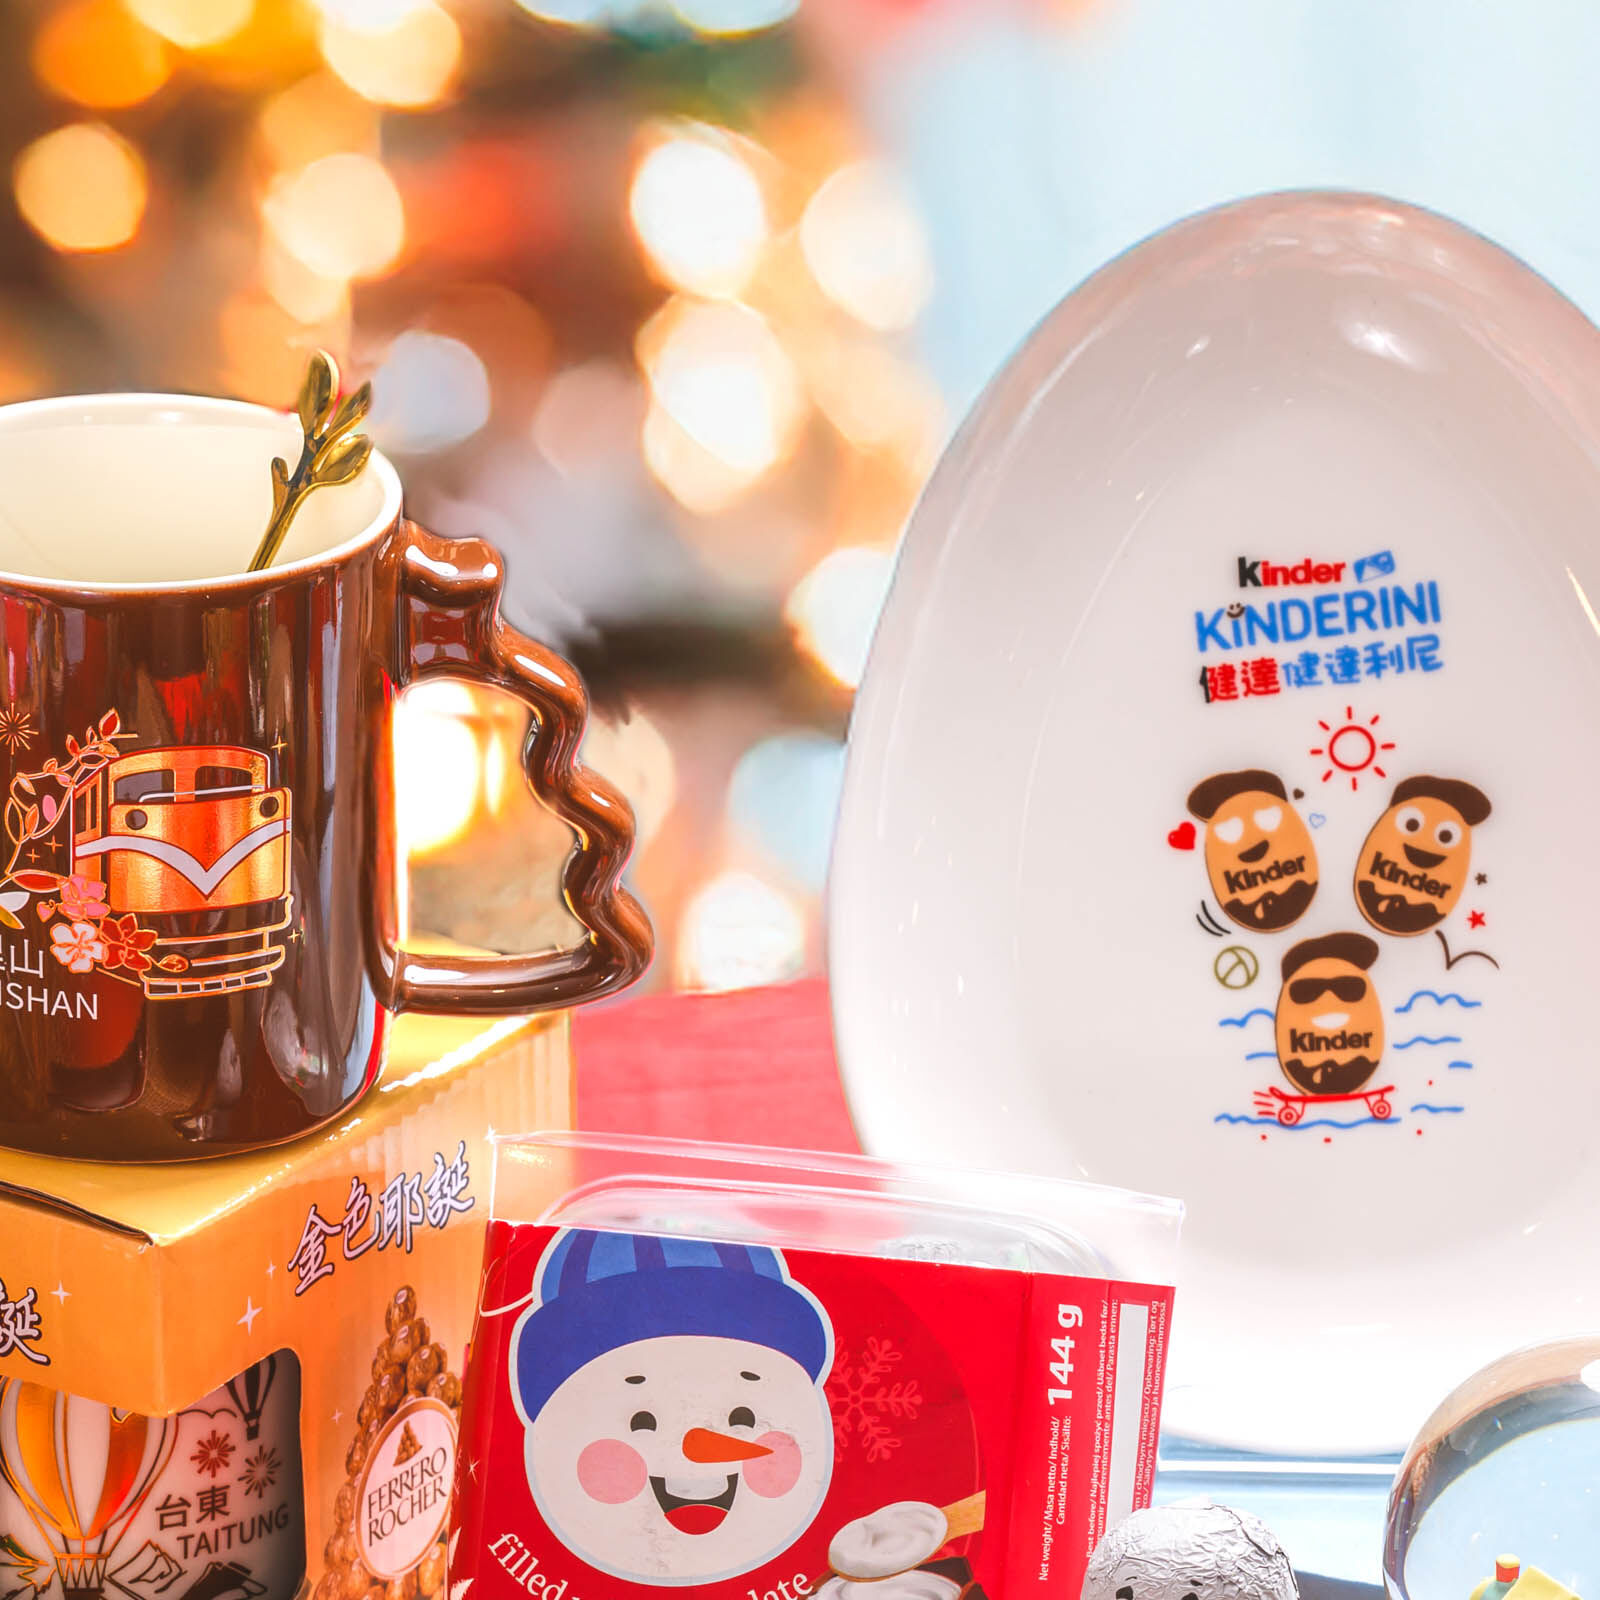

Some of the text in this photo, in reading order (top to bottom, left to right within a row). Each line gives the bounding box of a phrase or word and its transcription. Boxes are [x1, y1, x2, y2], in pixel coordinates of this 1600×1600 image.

[1238, 556, 1346, 587] Kinder
[1224, 853, 1306, 894] Kinder
[1370, 851, 1451, 900] Kinder
[1289, 1028, 1373, 1053] Kinder
[289, 1140, 475, 1297] 金色耶誕
[1048, 1303, 1083, 1405] 144 g
[365, 1445, 448, 1515] FERRERO
[1056, 1481, 1067, 1525] Cantidad
[154, 1483, 231, 1531] 台東
[176, 1502, 290, 1560] TAITUNG
[367, 1475, 448, 1546] ROCHER
[1038, 1565, 1048, 1581] Net
